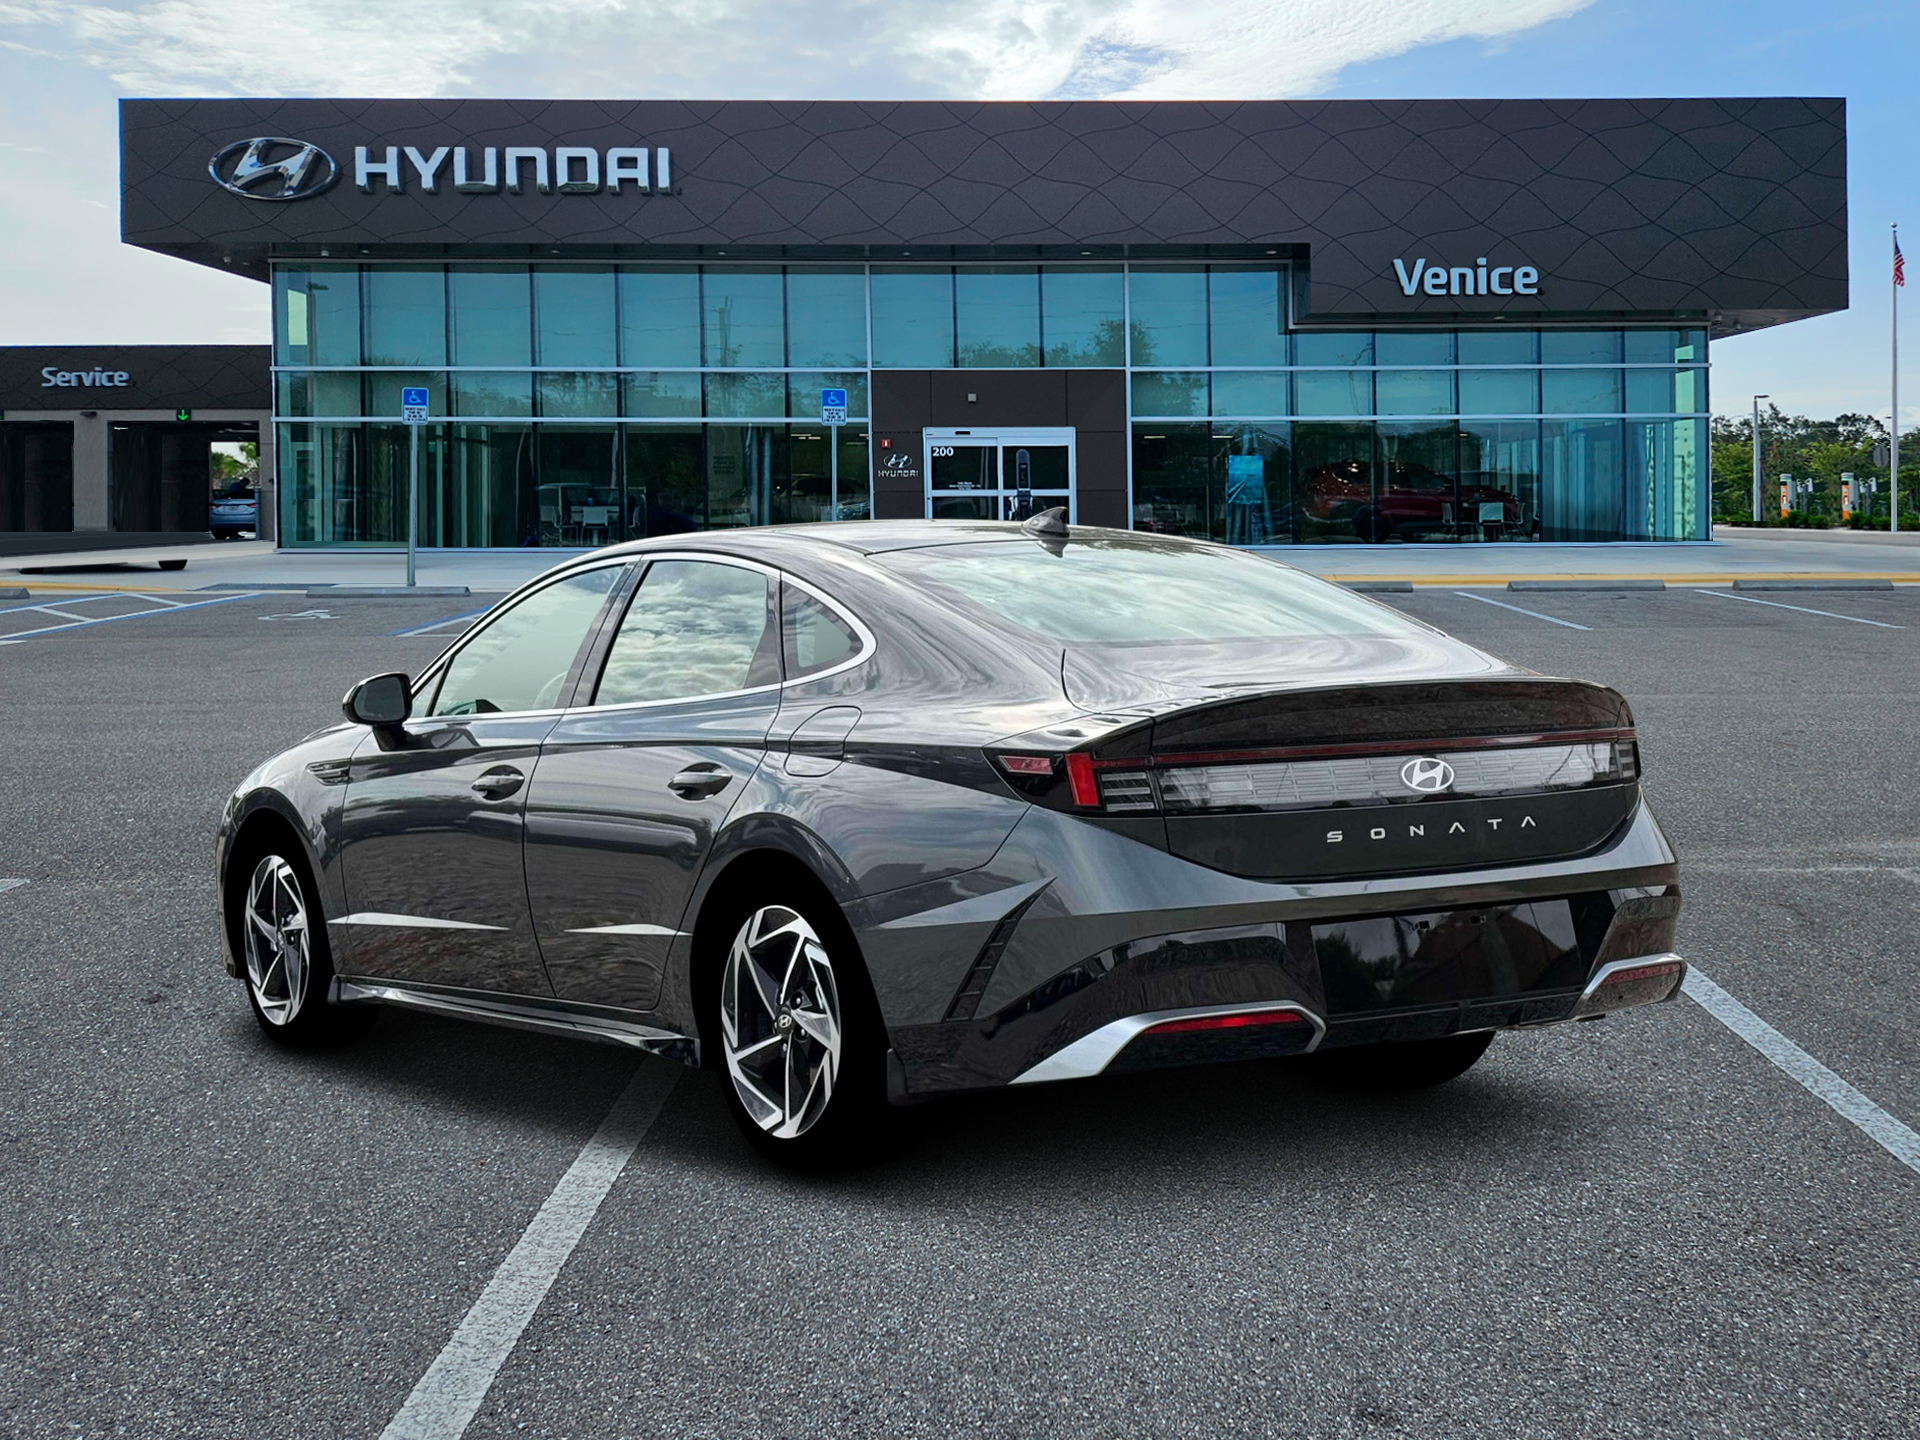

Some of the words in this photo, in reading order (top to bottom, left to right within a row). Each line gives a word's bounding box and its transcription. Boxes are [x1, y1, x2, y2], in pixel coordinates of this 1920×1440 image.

[354, 146, 672, 194] HYUNDAI
[1392, 257, 1539, 296] Venice
[41, 366, 129, 387] Service
[932, 446, 954, 457] 200
[877, 470, 919, 478] HYUNDAI
[1326, 815, 1537, 843] SONATA
